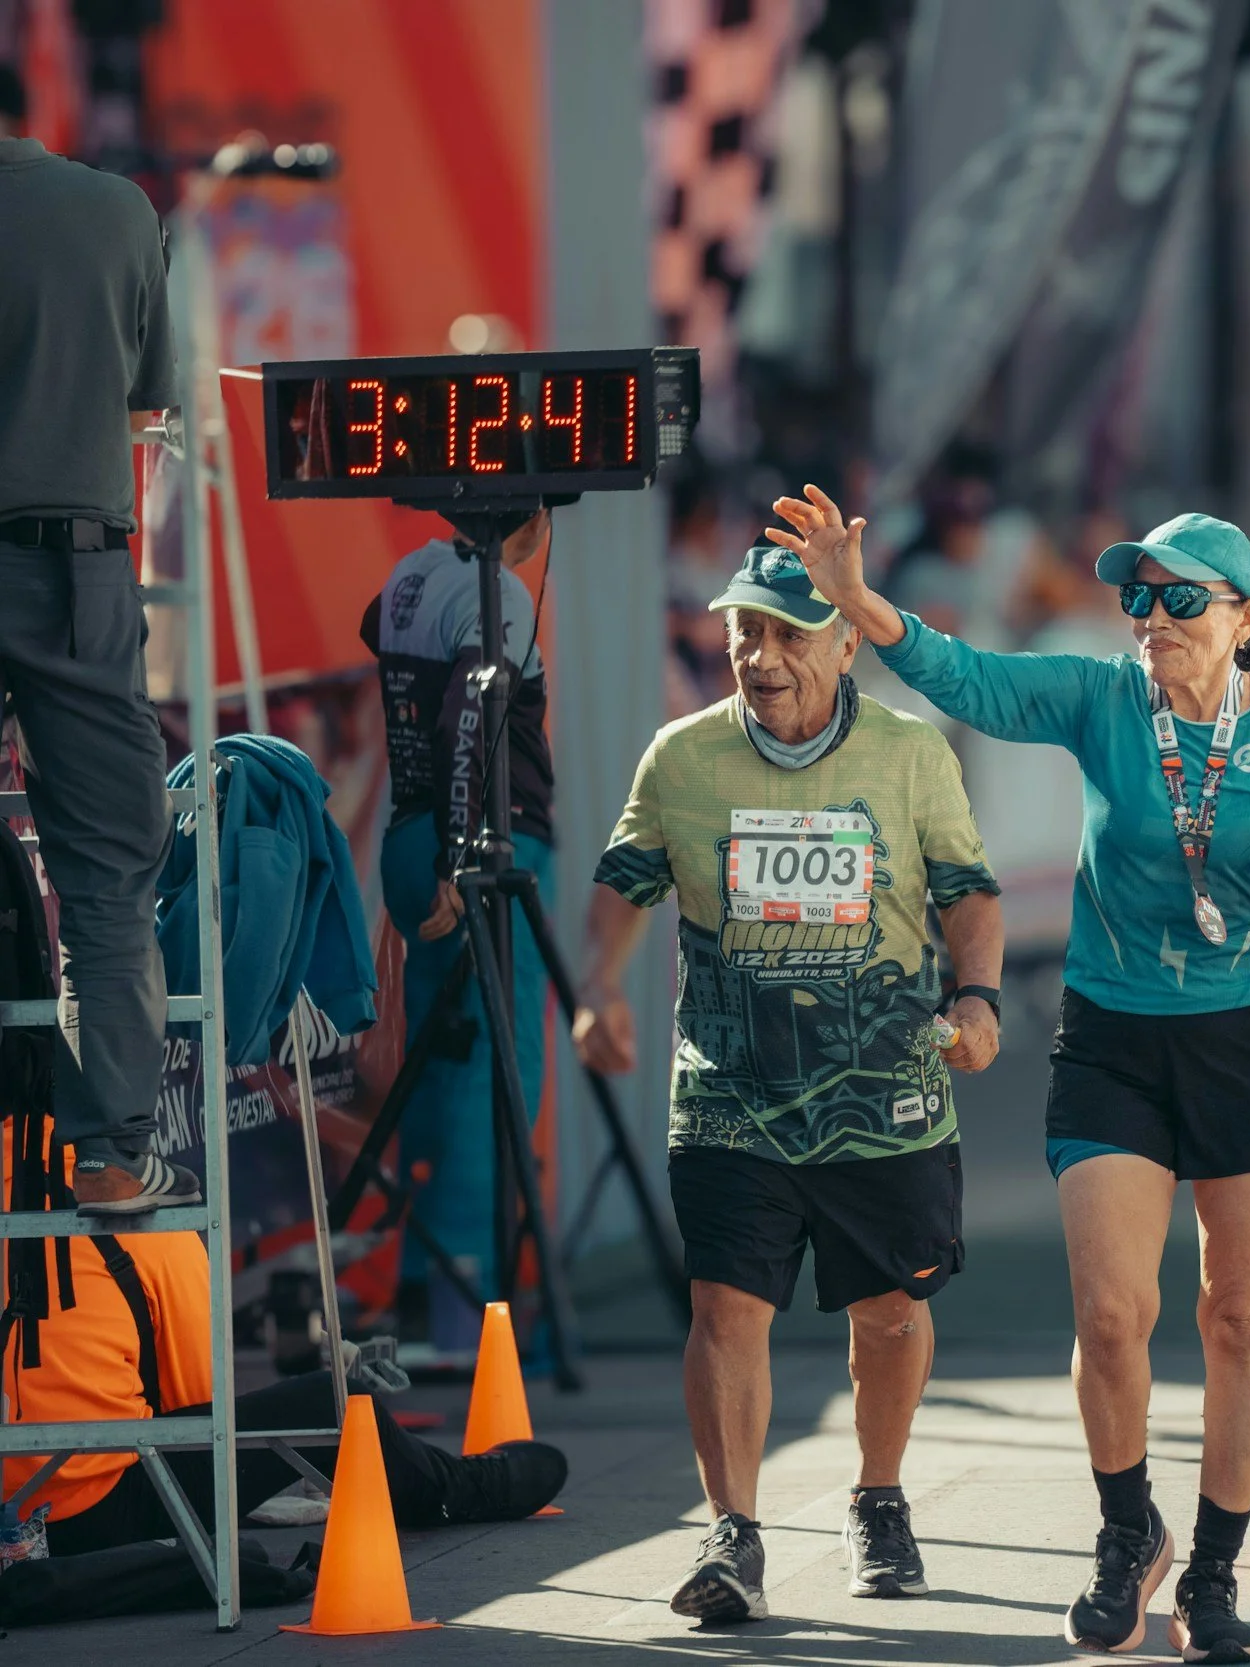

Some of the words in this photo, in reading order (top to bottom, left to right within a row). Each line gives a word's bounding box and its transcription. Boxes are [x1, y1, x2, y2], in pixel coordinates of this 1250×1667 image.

[790, 816, 814, 829] 21K
[755, 846, 857, 886] 1003
[736, 904, 760, 915] 1003
[806, 906, 832, 917] 1003
[736, 951, 782, 968] 12K
[783, 949, 866, 965] 2022
[170, 1037, 192, 1071] DE
[78, 1160, 105, 1169] adidas
